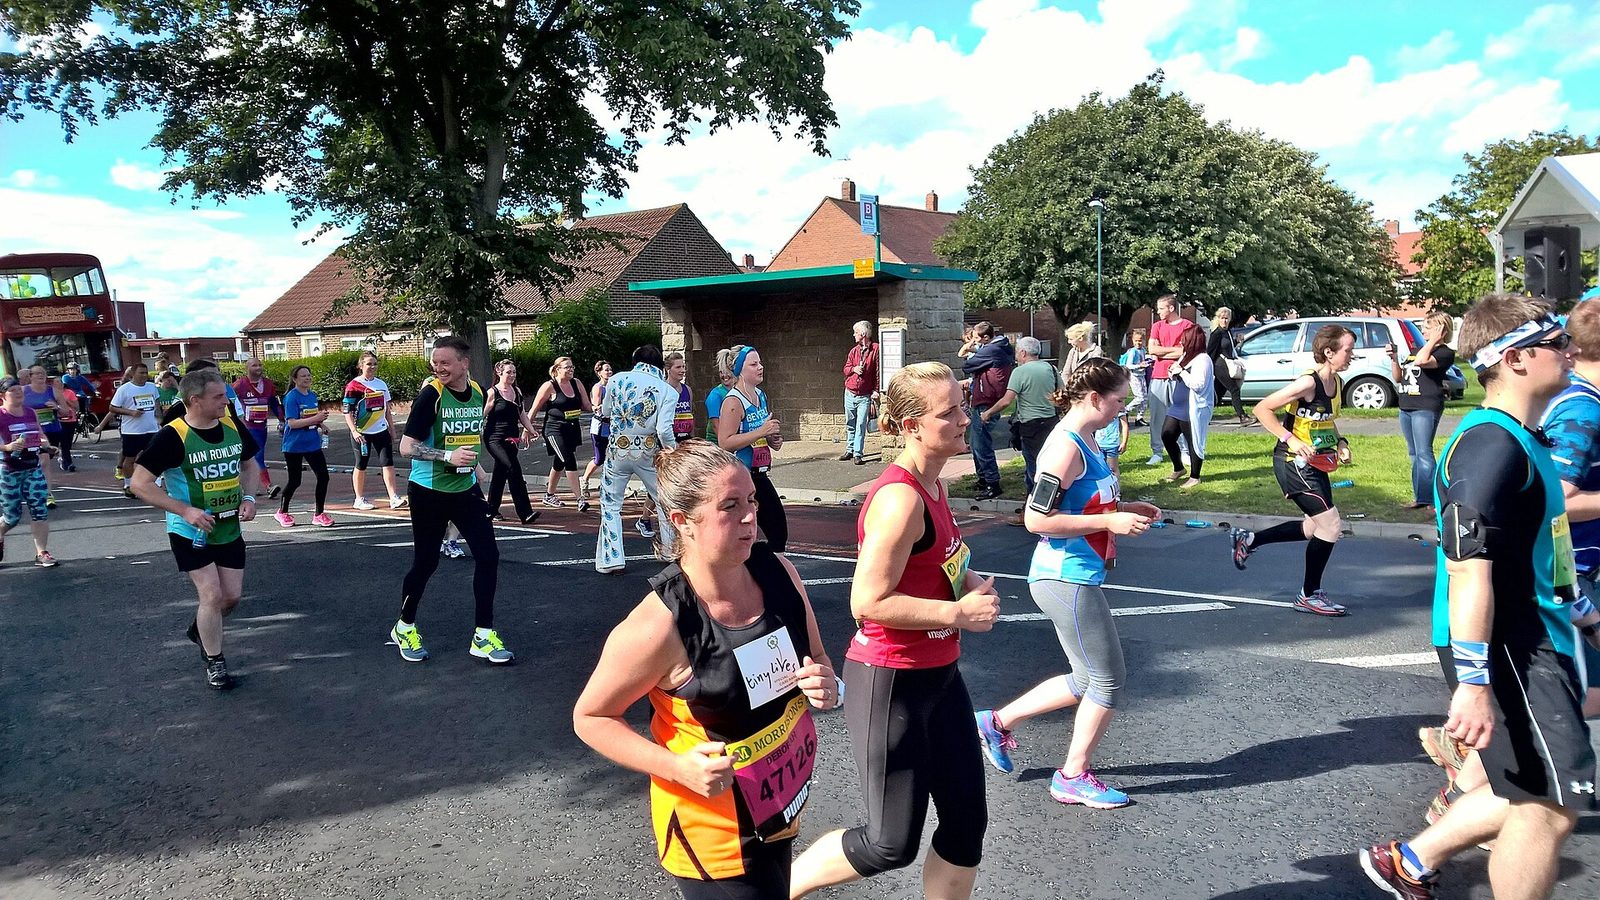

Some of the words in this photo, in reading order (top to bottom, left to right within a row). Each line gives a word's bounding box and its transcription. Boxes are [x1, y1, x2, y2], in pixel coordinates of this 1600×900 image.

[865, 203, 873, 214] B
[442, 407, 454, 418] IAN
[188, 451, 207, 464] IAIN
[745, 672, 773, 690] tiny
[770, 657, 796, 674] lives
[753, 698, 805, 753] MORRISONS
[760, 733, 815, 801] 47126
